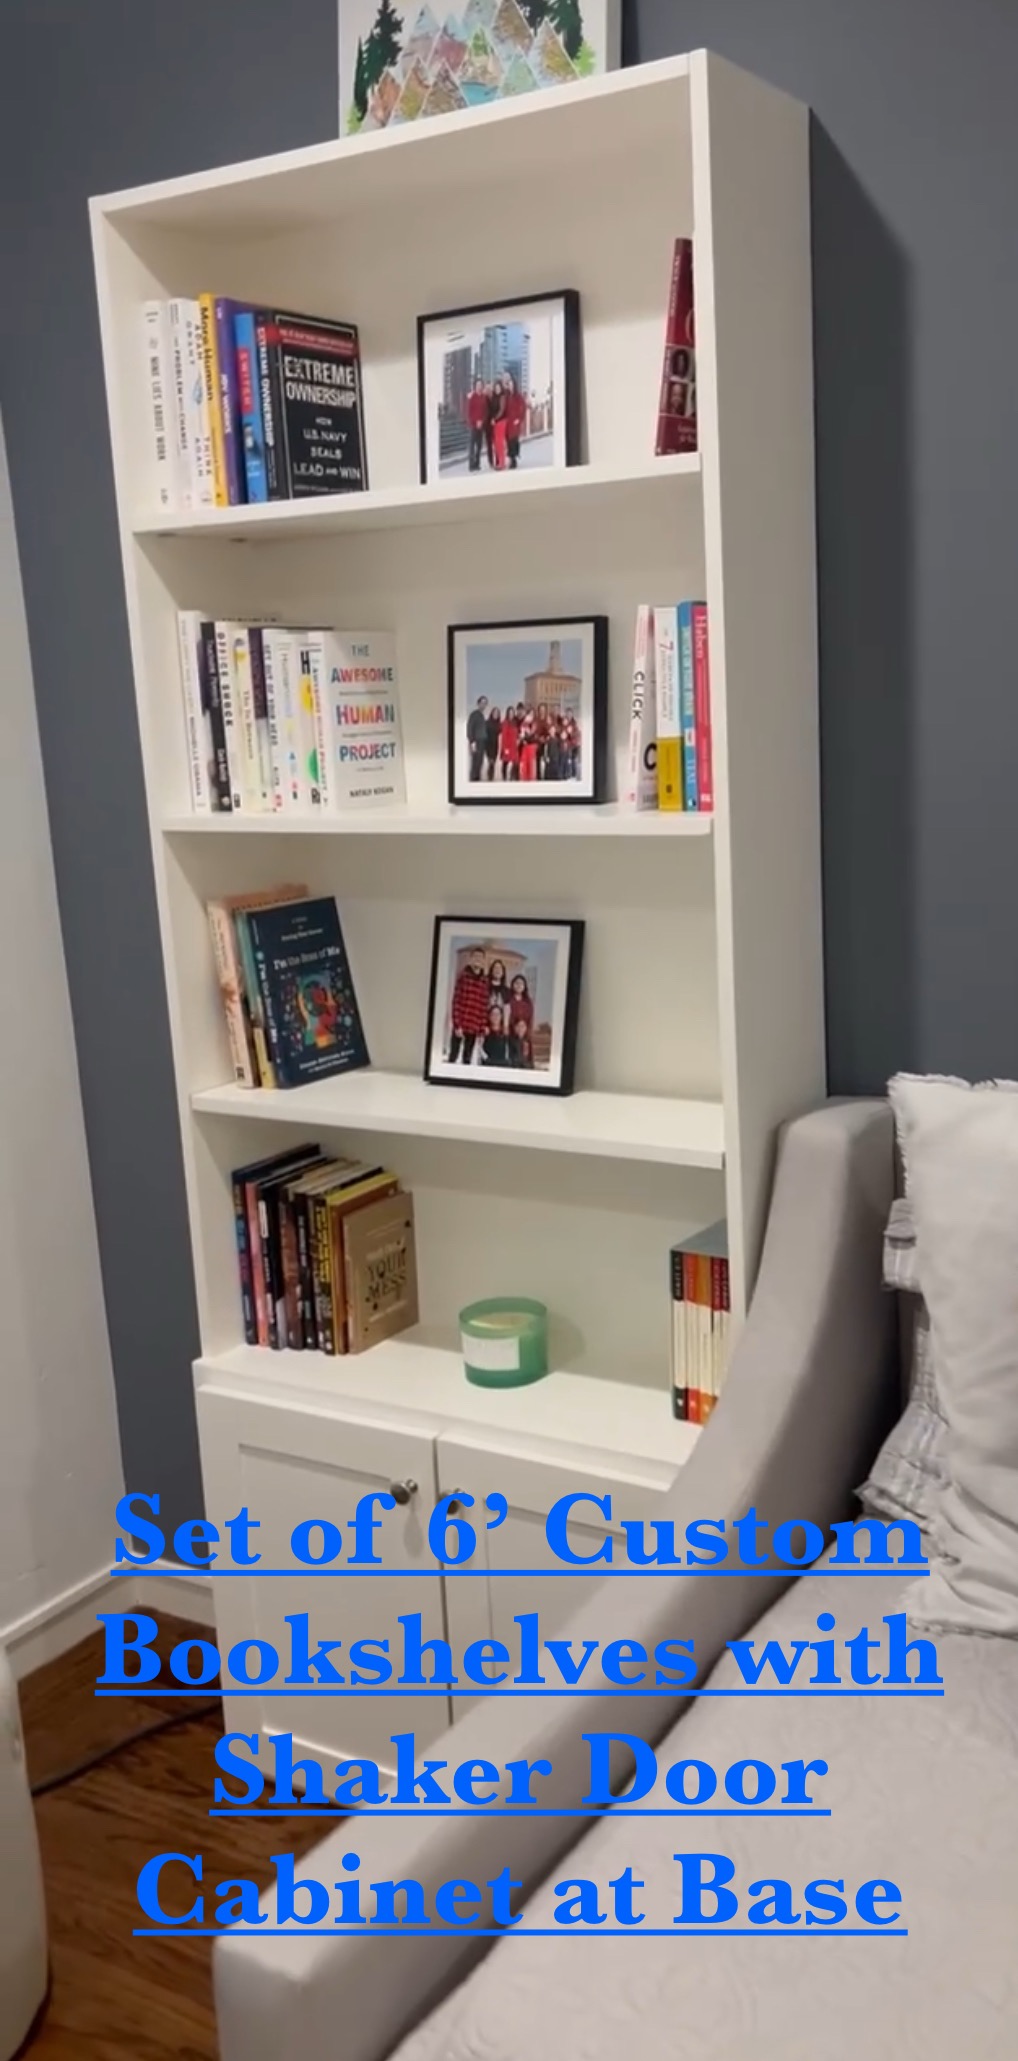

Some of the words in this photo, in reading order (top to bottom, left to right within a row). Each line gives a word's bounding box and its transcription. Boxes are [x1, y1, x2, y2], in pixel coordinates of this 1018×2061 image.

[200, 305, 209, 345] More
[257, 326, 269, 376] EXTREME
[203, 348, 214, 402] Human
[283, 355, 355, 388] EXTREME
[285, 380, 357, 409] OWNERSHIP
[153, 404, 164, 431] ABOUT
[261, 377, 275, 447] OWNERSHIP
[320, 430, 348, 443] NAVY
[310, 445, 343, 460] SEALS
[293, 461, 325, 477] LEAD
[340, 466, 362, 480] WIN
[216, 631, 228, 677] OFFICE
[351, 644, 370, 657] THE
[331, 667, 394, 684] AWESOME
[221, 684, 233, 727] SHOCK
[631, 670, 646, 721] CLICK
[336, 703, 395, 726] HUMAN
[339, 742, 397, 763] PROJECT
